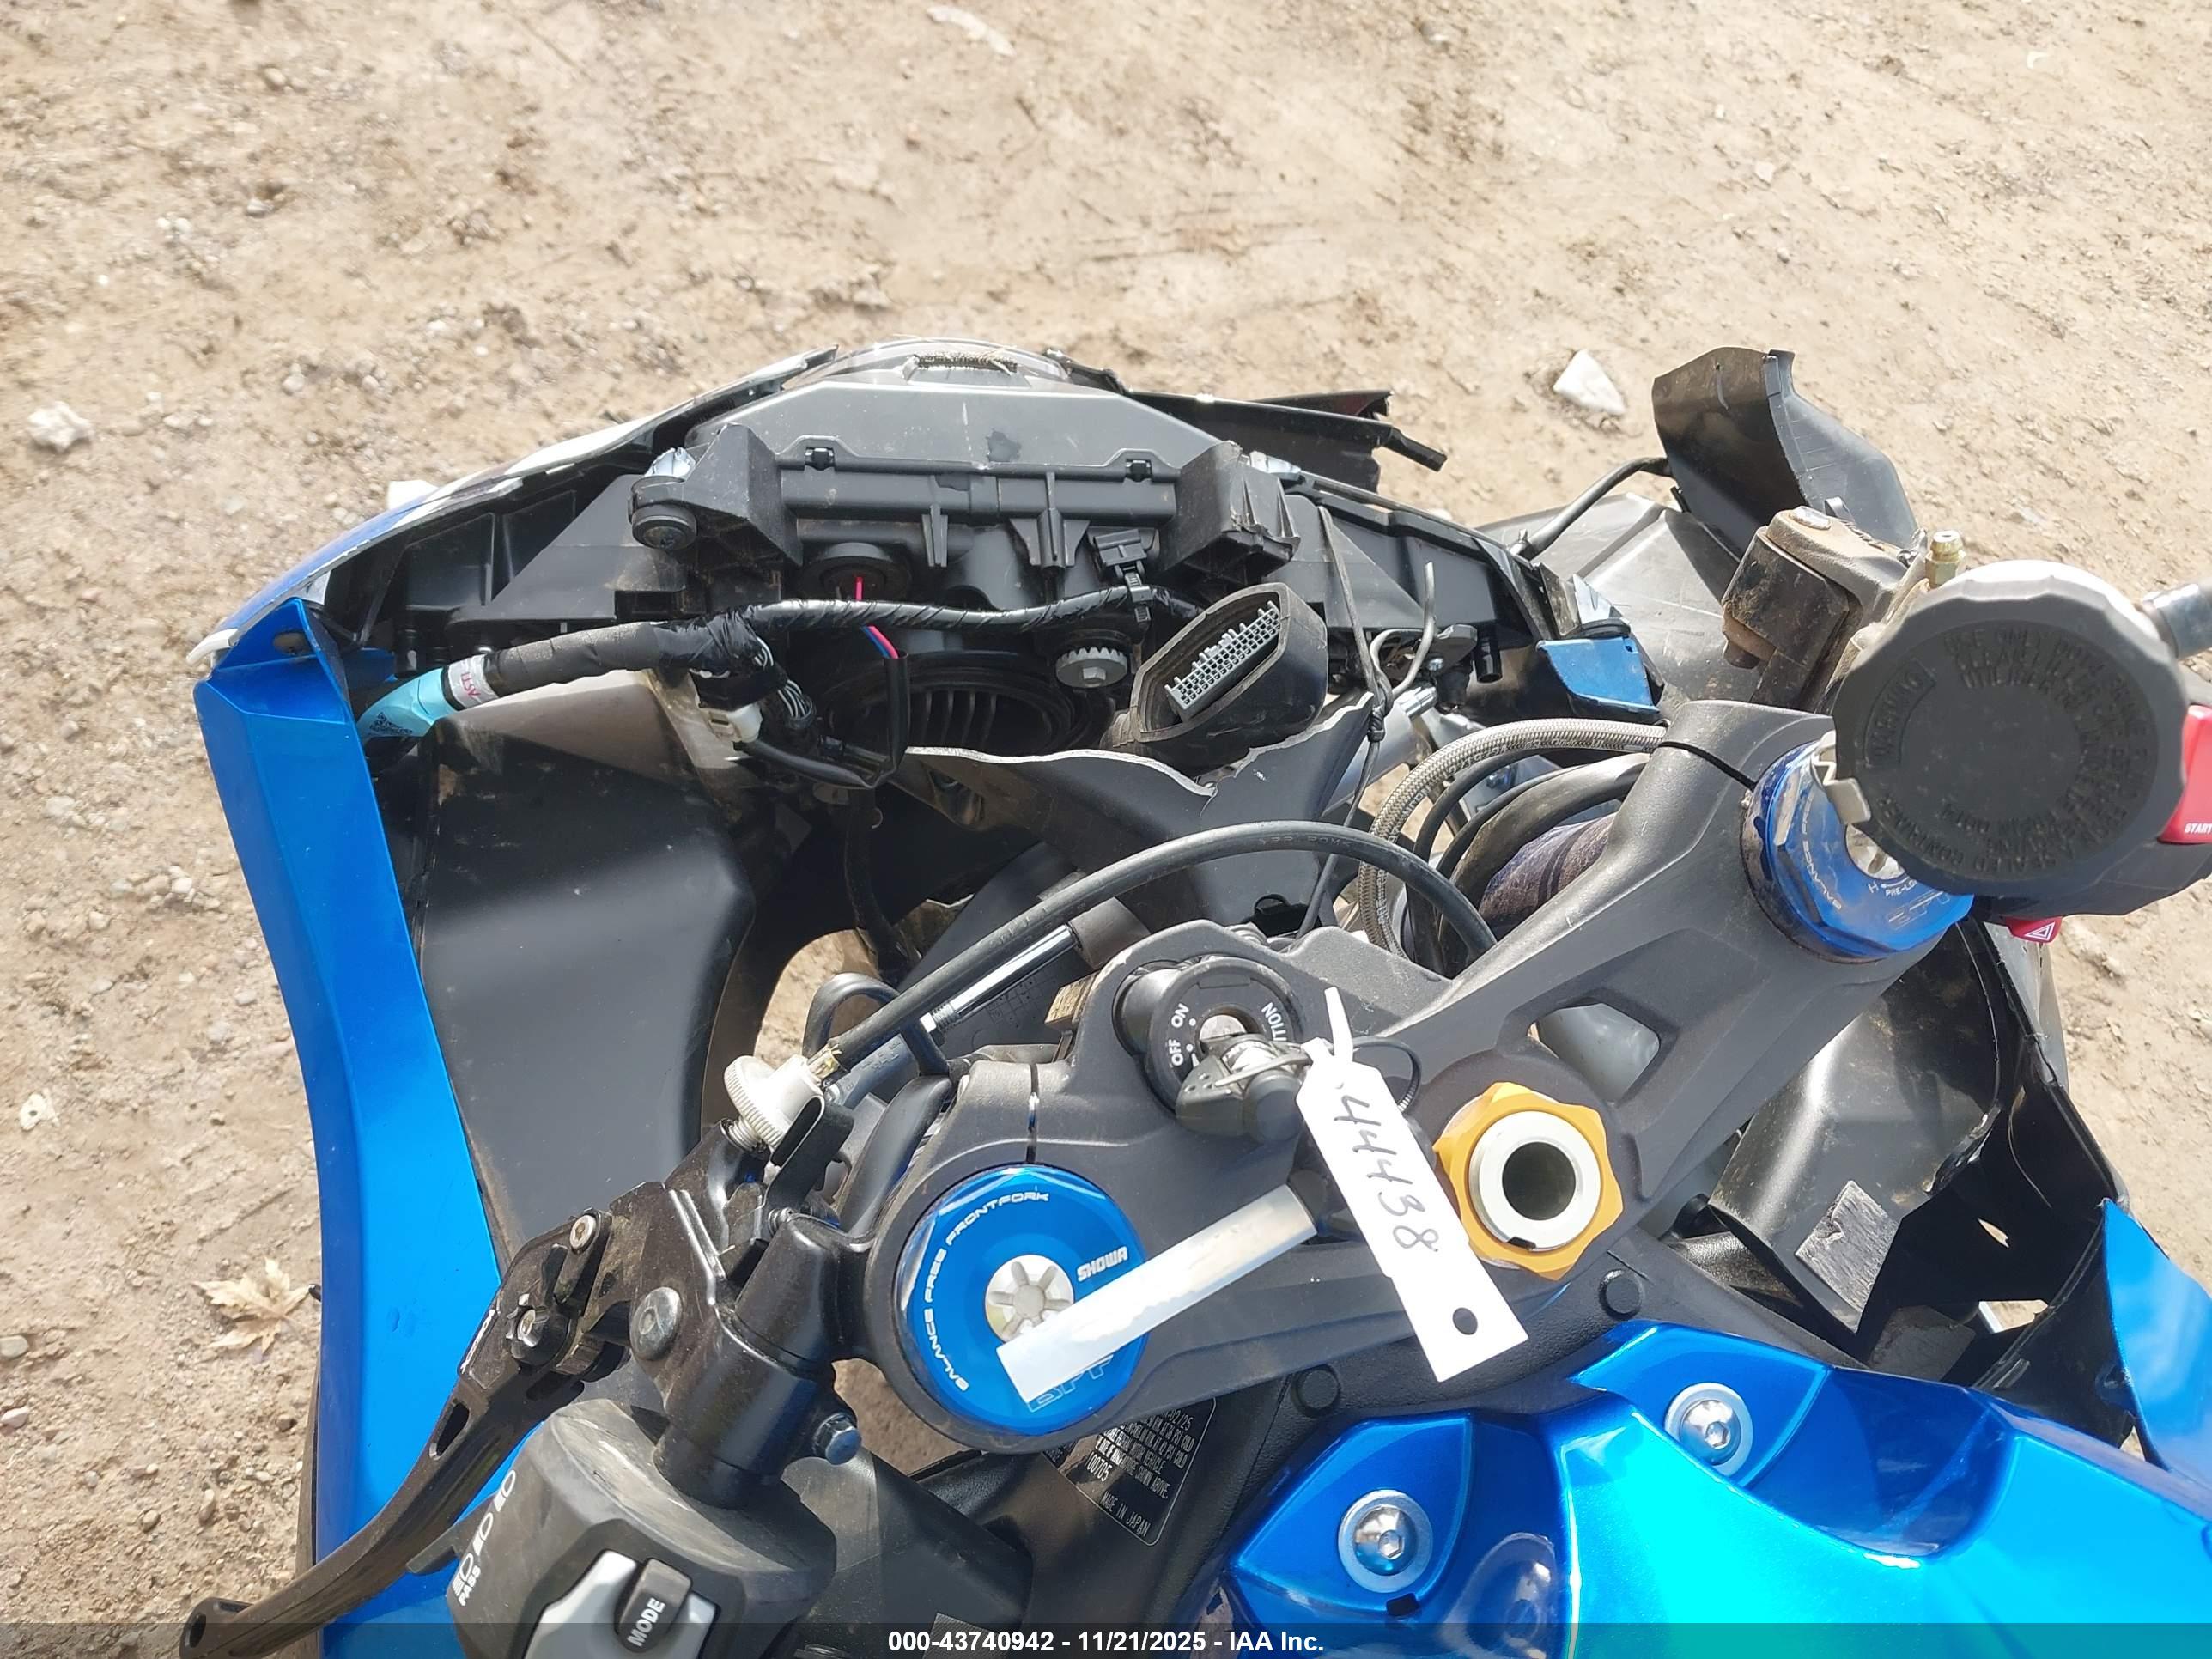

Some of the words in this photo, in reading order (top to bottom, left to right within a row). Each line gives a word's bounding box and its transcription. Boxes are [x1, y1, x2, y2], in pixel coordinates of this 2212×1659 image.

[1171, 1002, 1189, 1028] ON
[1261, 1001, 1287, 1042] ITION
[1168, 1039, 1184, 1066] OFF
[1333, 1095, 1440, 1253] 44438
[945, 1191, 1049, 1247] FRONTFORK
[924, 1248, 947, 1303] FREE
[1076, 1246, 1128, 1282] SHOWA
[924, 1308, 969, 1391] BALANCE
[1085, 1452, 1112, 1481] 100705
[1102, 1491, 1118, 1511] MADE
[1116, 1504, 1127, 1520] IN
[1127, 1513, 1151, 1536] JAPAN
[458, 1565, 481, 1606] PASS
[627, 1597, 665, 1647] MODE
